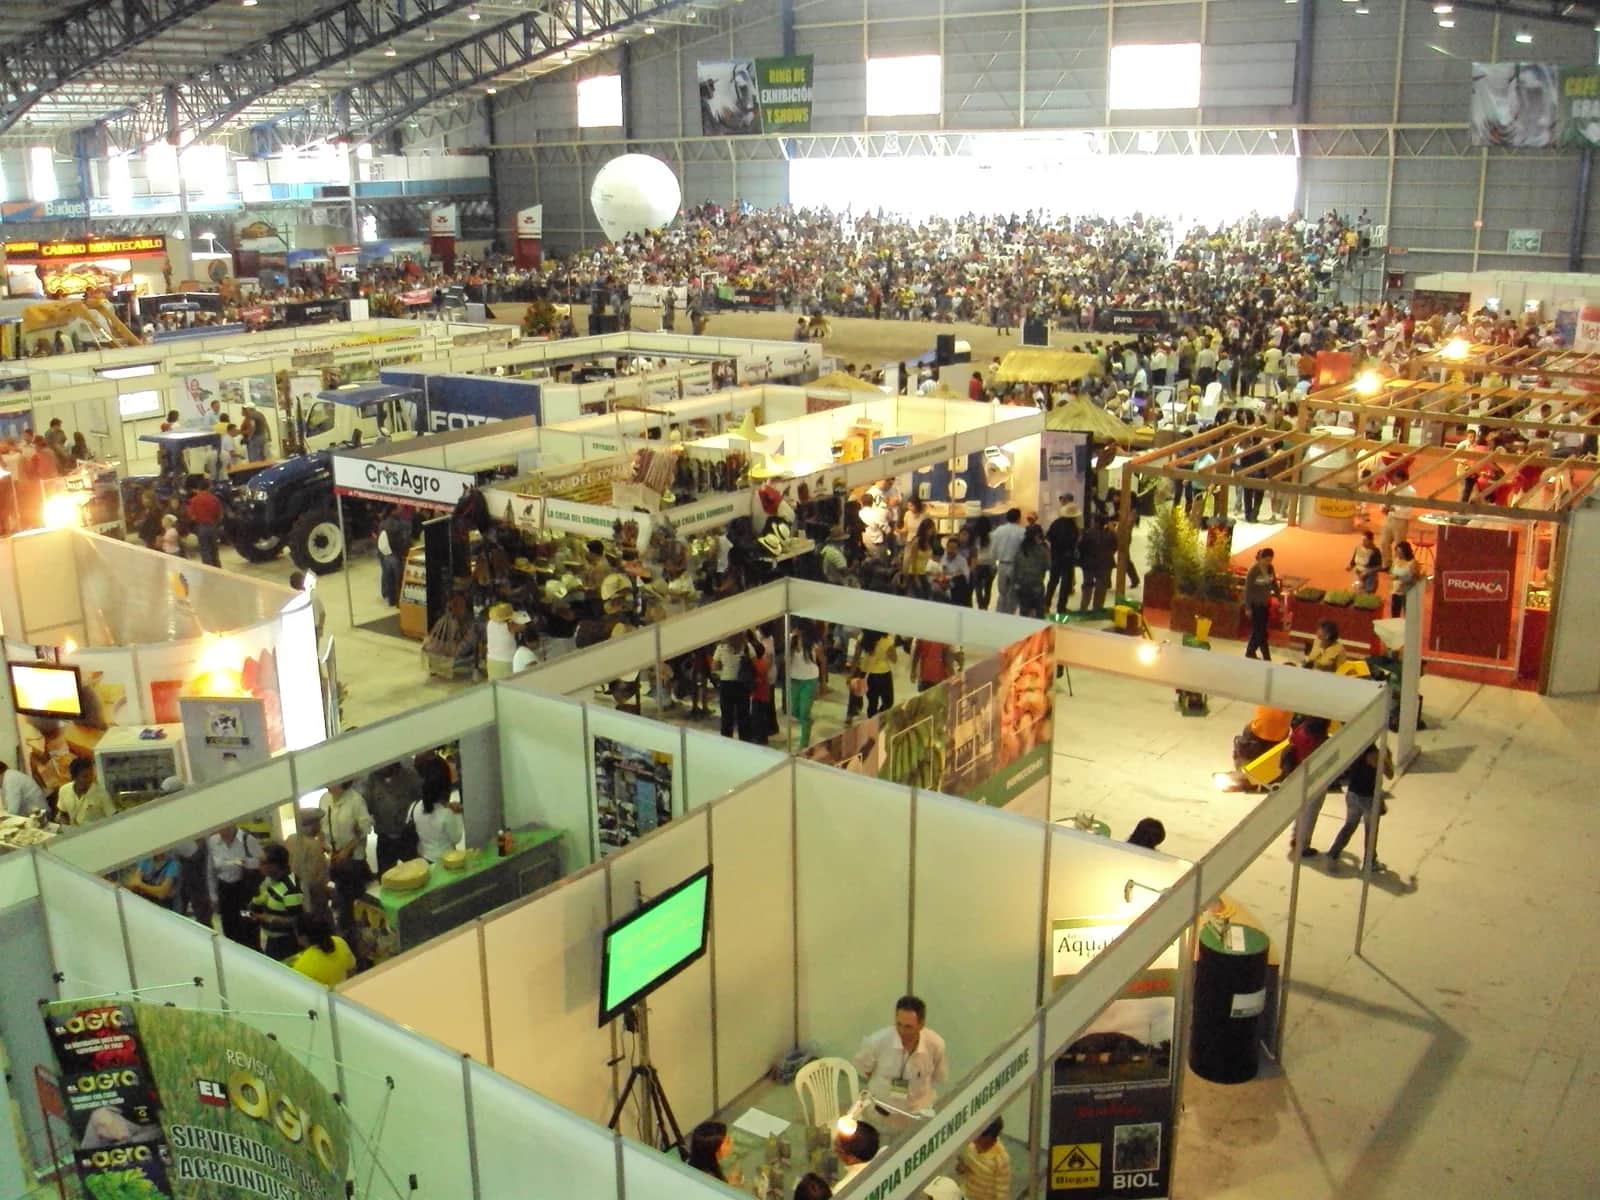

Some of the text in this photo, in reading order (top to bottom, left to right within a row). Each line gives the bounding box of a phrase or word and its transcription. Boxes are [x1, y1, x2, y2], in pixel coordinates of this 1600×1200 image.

[768, 66, 806, 84] RING DE
[766, 107, 808, 123] Y SHOWS
[45, 200, 86, 217] Budget
[42, 243, 86, 256] CASINO
[88, 239, 162, 253] MONTECARLO
[572, 471, 592, 487] DEL
[547, 507, 553, 517] LA
[555, 511, 570, 520] CASA
[571, 514, 581, 522] DEL
[1447, 578, 1503, 594] PRONACA
[226, 1049, 276, 1083] REVISTA
[199, 1080, 226, 1099] EL
[904, 1108, 969, 1179] BERATENDE
[970, 1048, 1030, 1117] INGENIEURE
[171, 1124, 276, 1170] SIRVIENDO
[1113, 1173, 1159, 1190] BIOL
